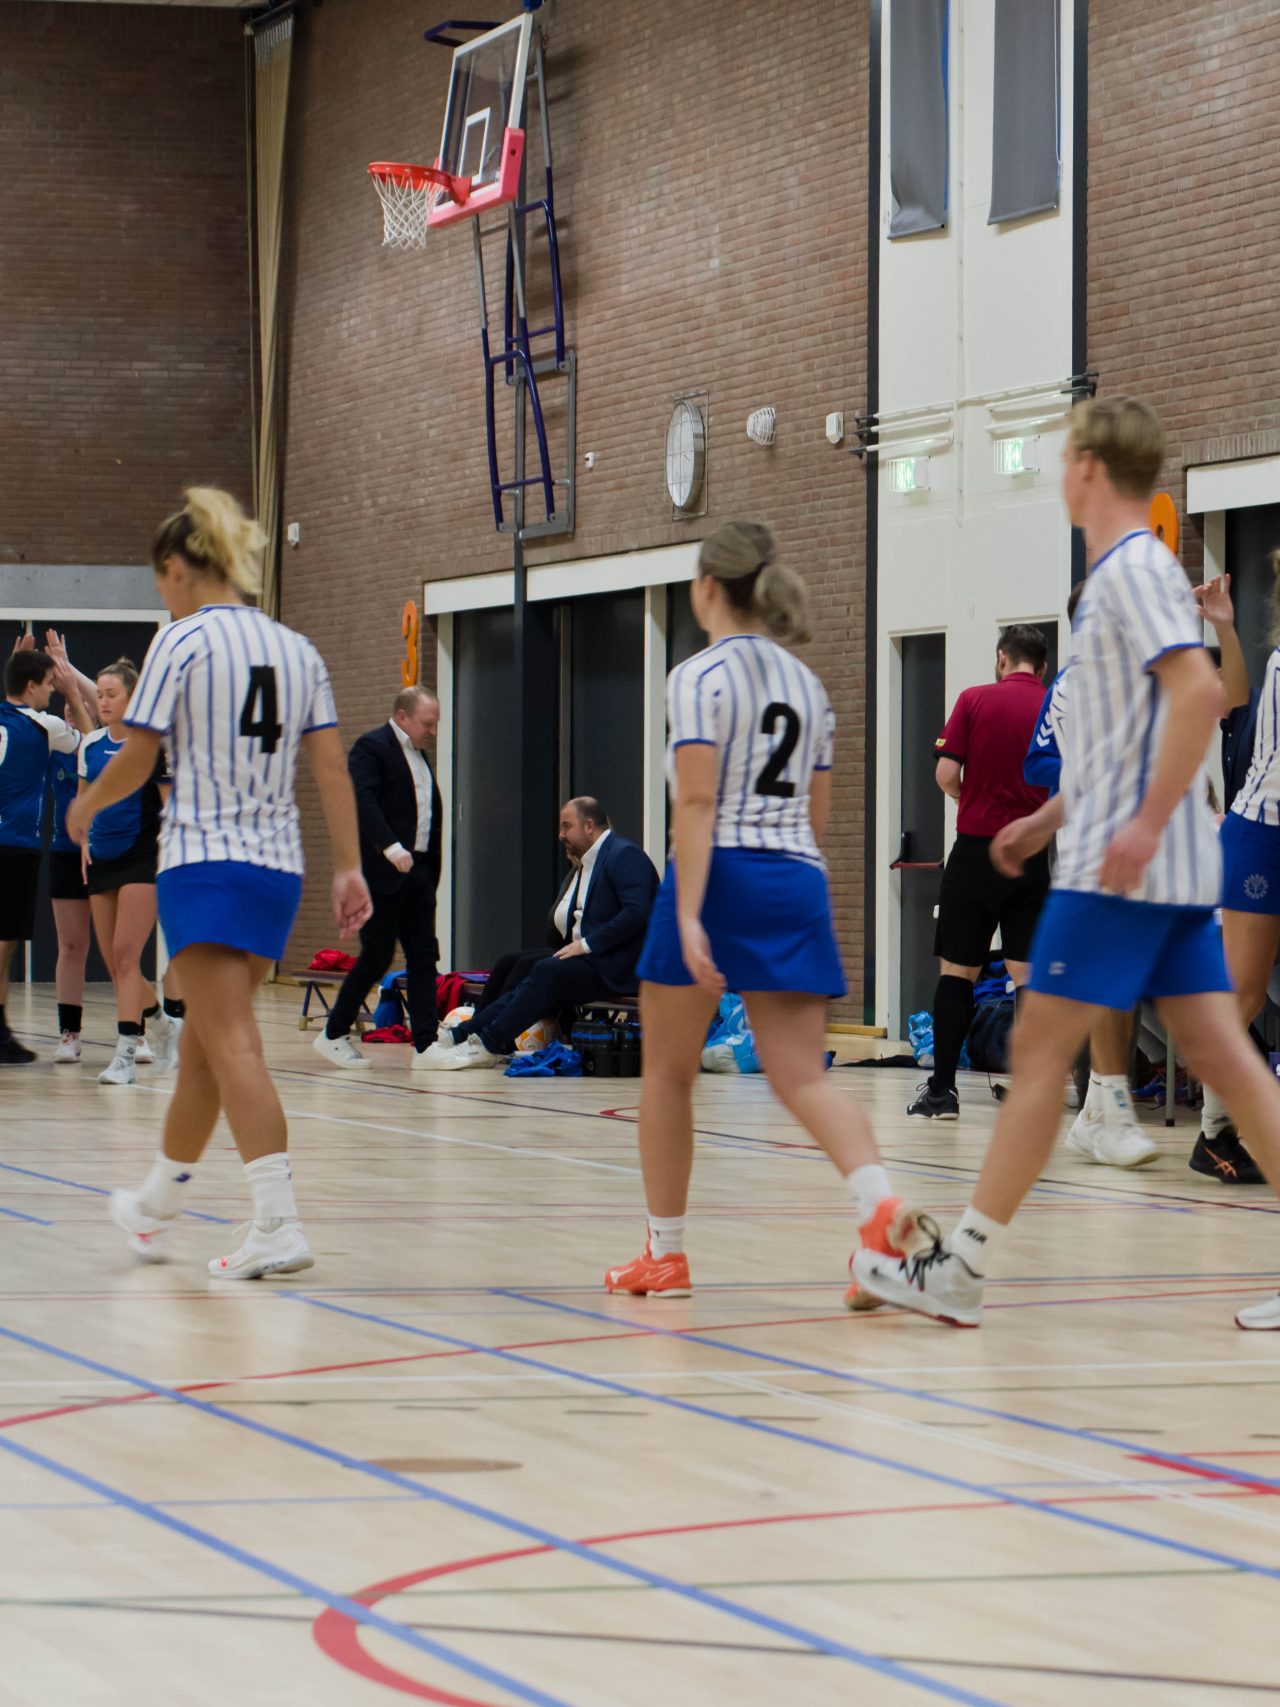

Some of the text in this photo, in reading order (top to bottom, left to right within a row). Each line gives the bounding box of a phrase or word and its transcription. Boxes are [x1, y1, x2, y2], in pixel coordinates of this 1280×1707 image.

[402, 600, 417, 688] 3
[239, 666, 283, 754] 4
[755, 702, 801, 797] 2
